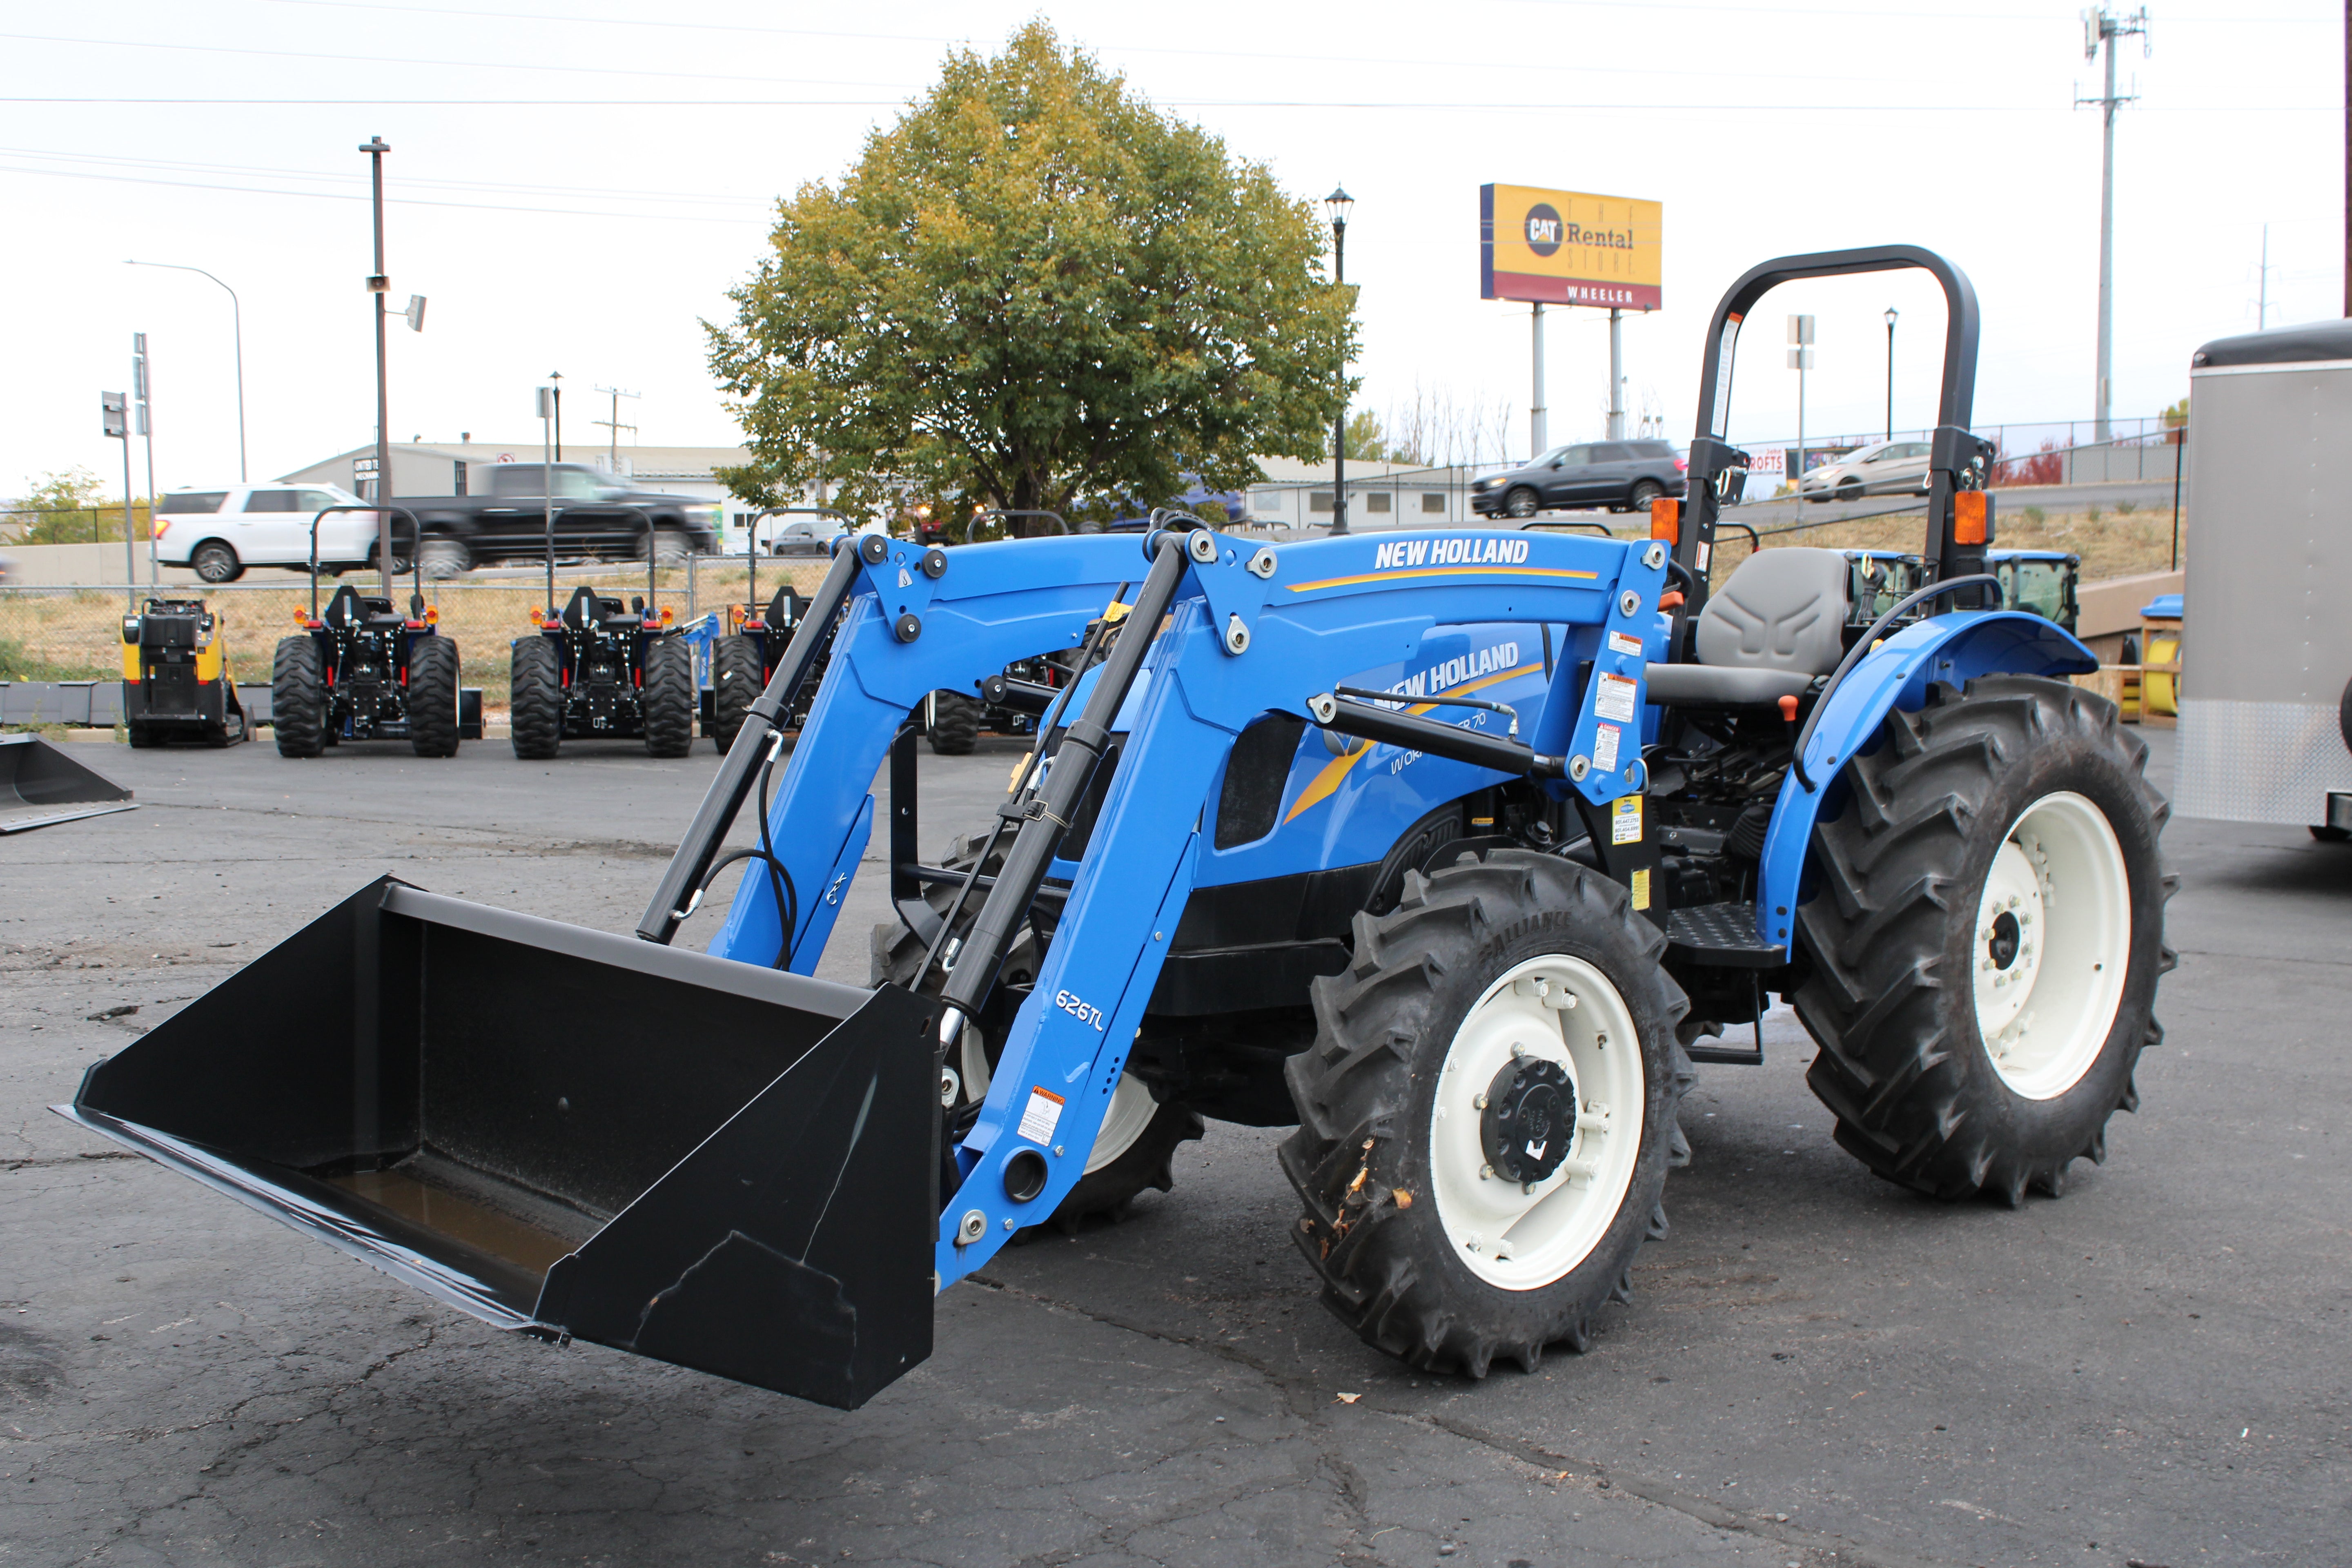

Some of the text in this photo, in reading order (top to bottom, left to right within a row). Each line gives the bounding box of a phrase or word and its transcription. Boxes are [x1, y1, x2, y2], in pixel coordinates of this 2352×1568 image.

[1530, 218, 1557, 243] CAT
[1567, 223, 1634, 249] Rental
[1567, 285, 1633, 303] WHEELER
[1745, 455, 1782, 470] ROFTS
[1374, 539, 1529, 570] NEW HOLLAND
[1430, 641, 1519, 695] HOLLAND
[1472, 712, 1486, 729] 70
[1493, 911, 1572, 959] ALLIANCE
[1056, 989, 1103, 1032] 626TL
[1039, 1090, 1063, 1105] WARNING
